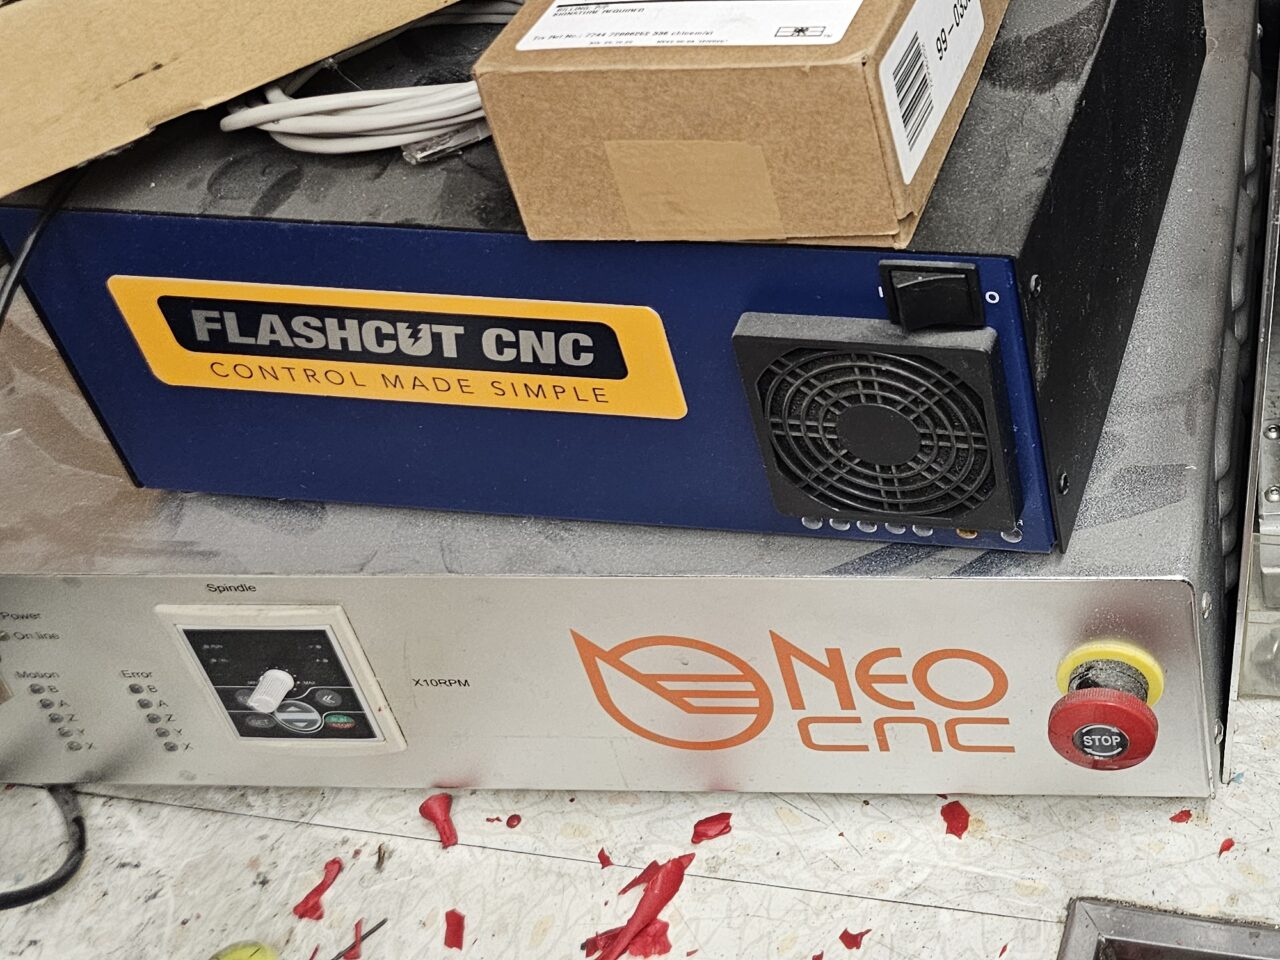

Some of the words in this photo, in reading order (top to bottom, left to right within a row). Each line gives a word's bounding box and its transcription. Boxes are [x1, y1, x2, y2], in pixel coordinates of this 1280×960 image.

[191, 308, 465, 359] FLASHCUT
[482, 329, 595, 368] CNC
[210, 360, 367, 388] CONTROL
[381, 372, 475, 395] MADE
[490, 380, 609, 405] SIMPLE
[206, 582, 257, 594] Spindle
[1, 611, 41, 620] Power
[13, 631, 33, 640] On
[15, 670, 60, 679] Motion
[121, 669, 153, 679] Error
[769, 630, 1009, 711] NEO
[412, 678, 470, 688] X10RPM
[1083, 734, 1121, 747] STOP
